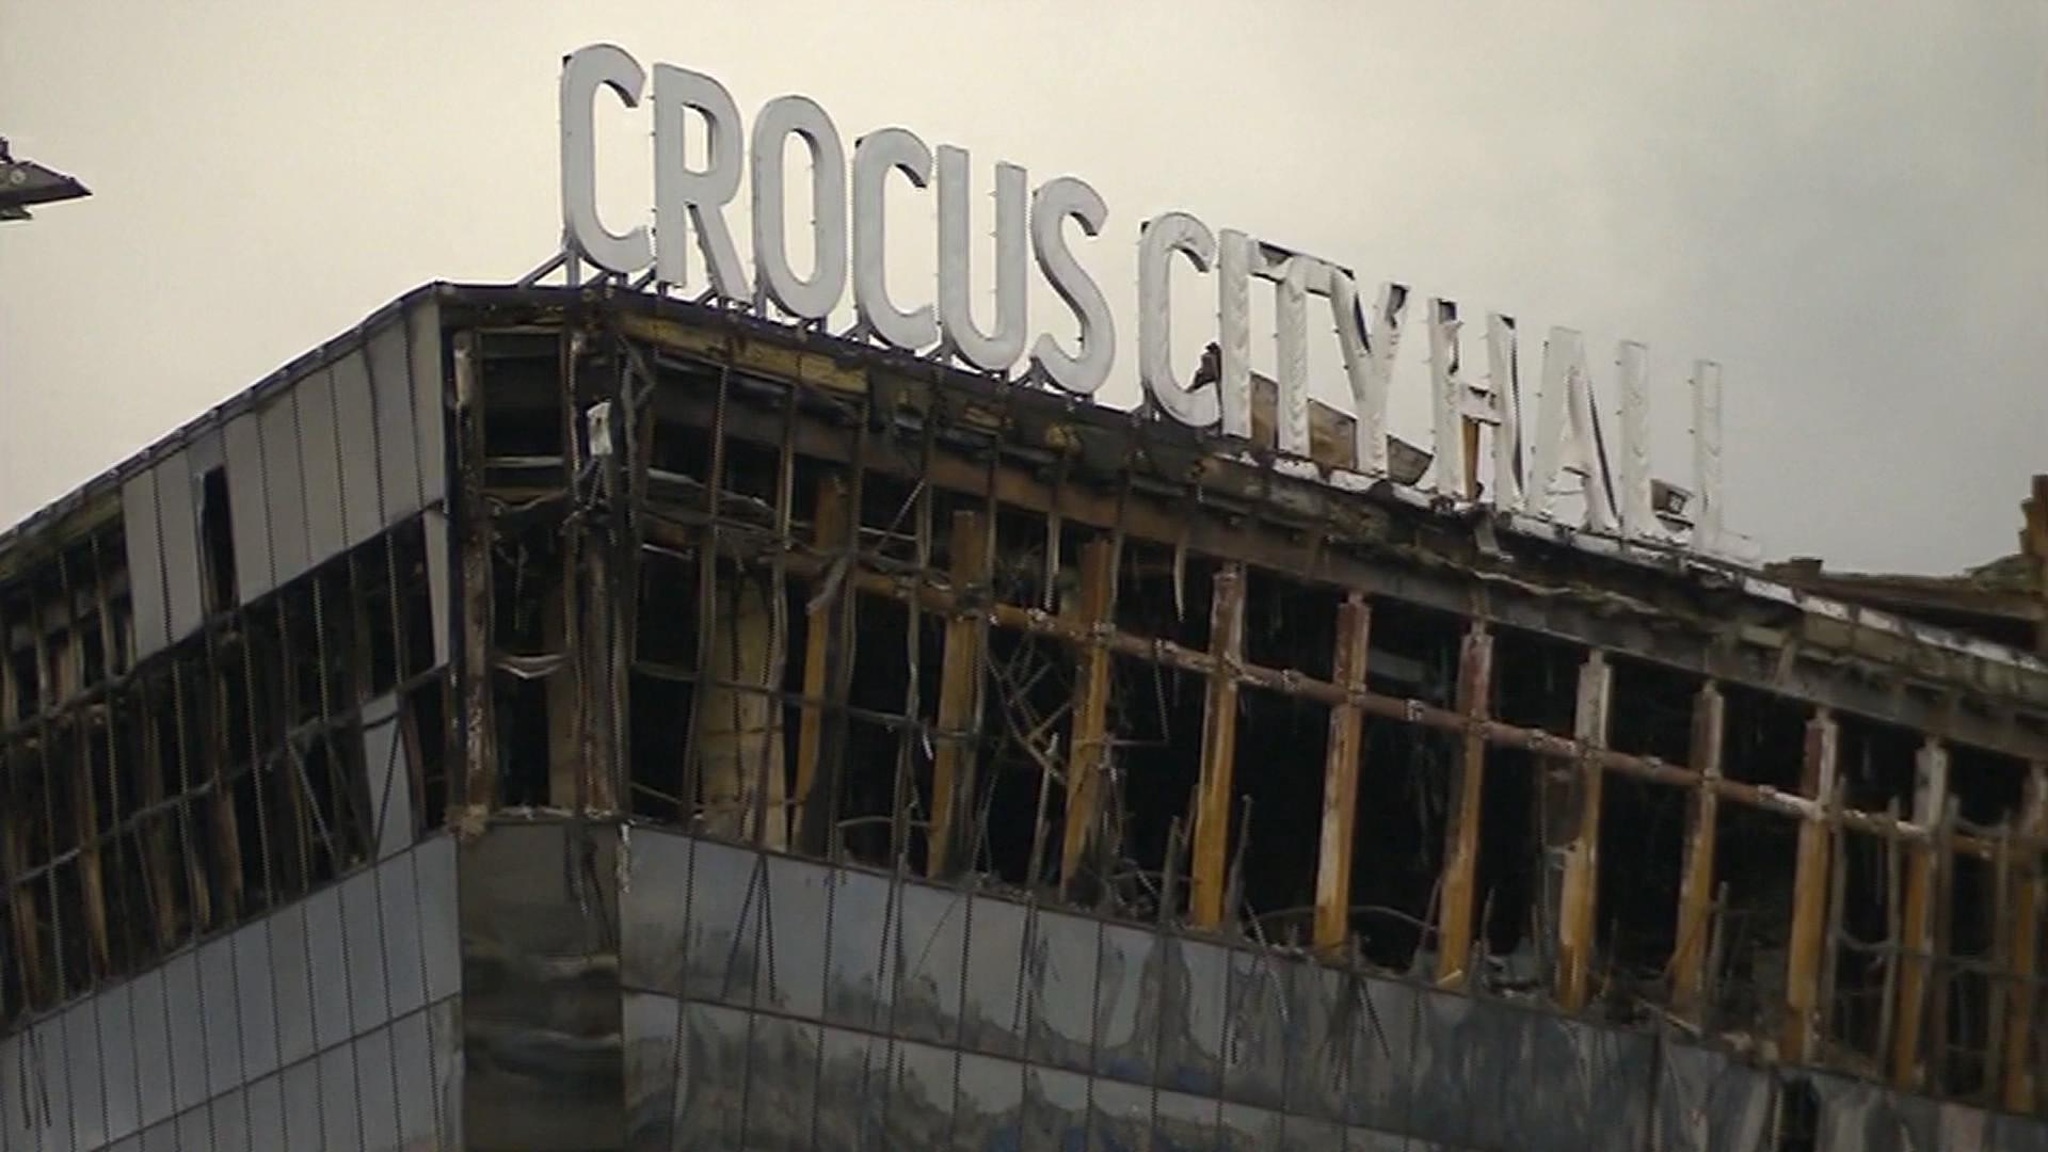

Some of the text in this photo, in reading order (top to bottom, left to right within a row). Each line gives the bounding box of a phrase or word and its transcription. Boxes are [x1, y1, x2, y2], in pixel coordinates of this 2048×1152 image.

[560, 43, 1762, 565] CROCUS CITY HALL
